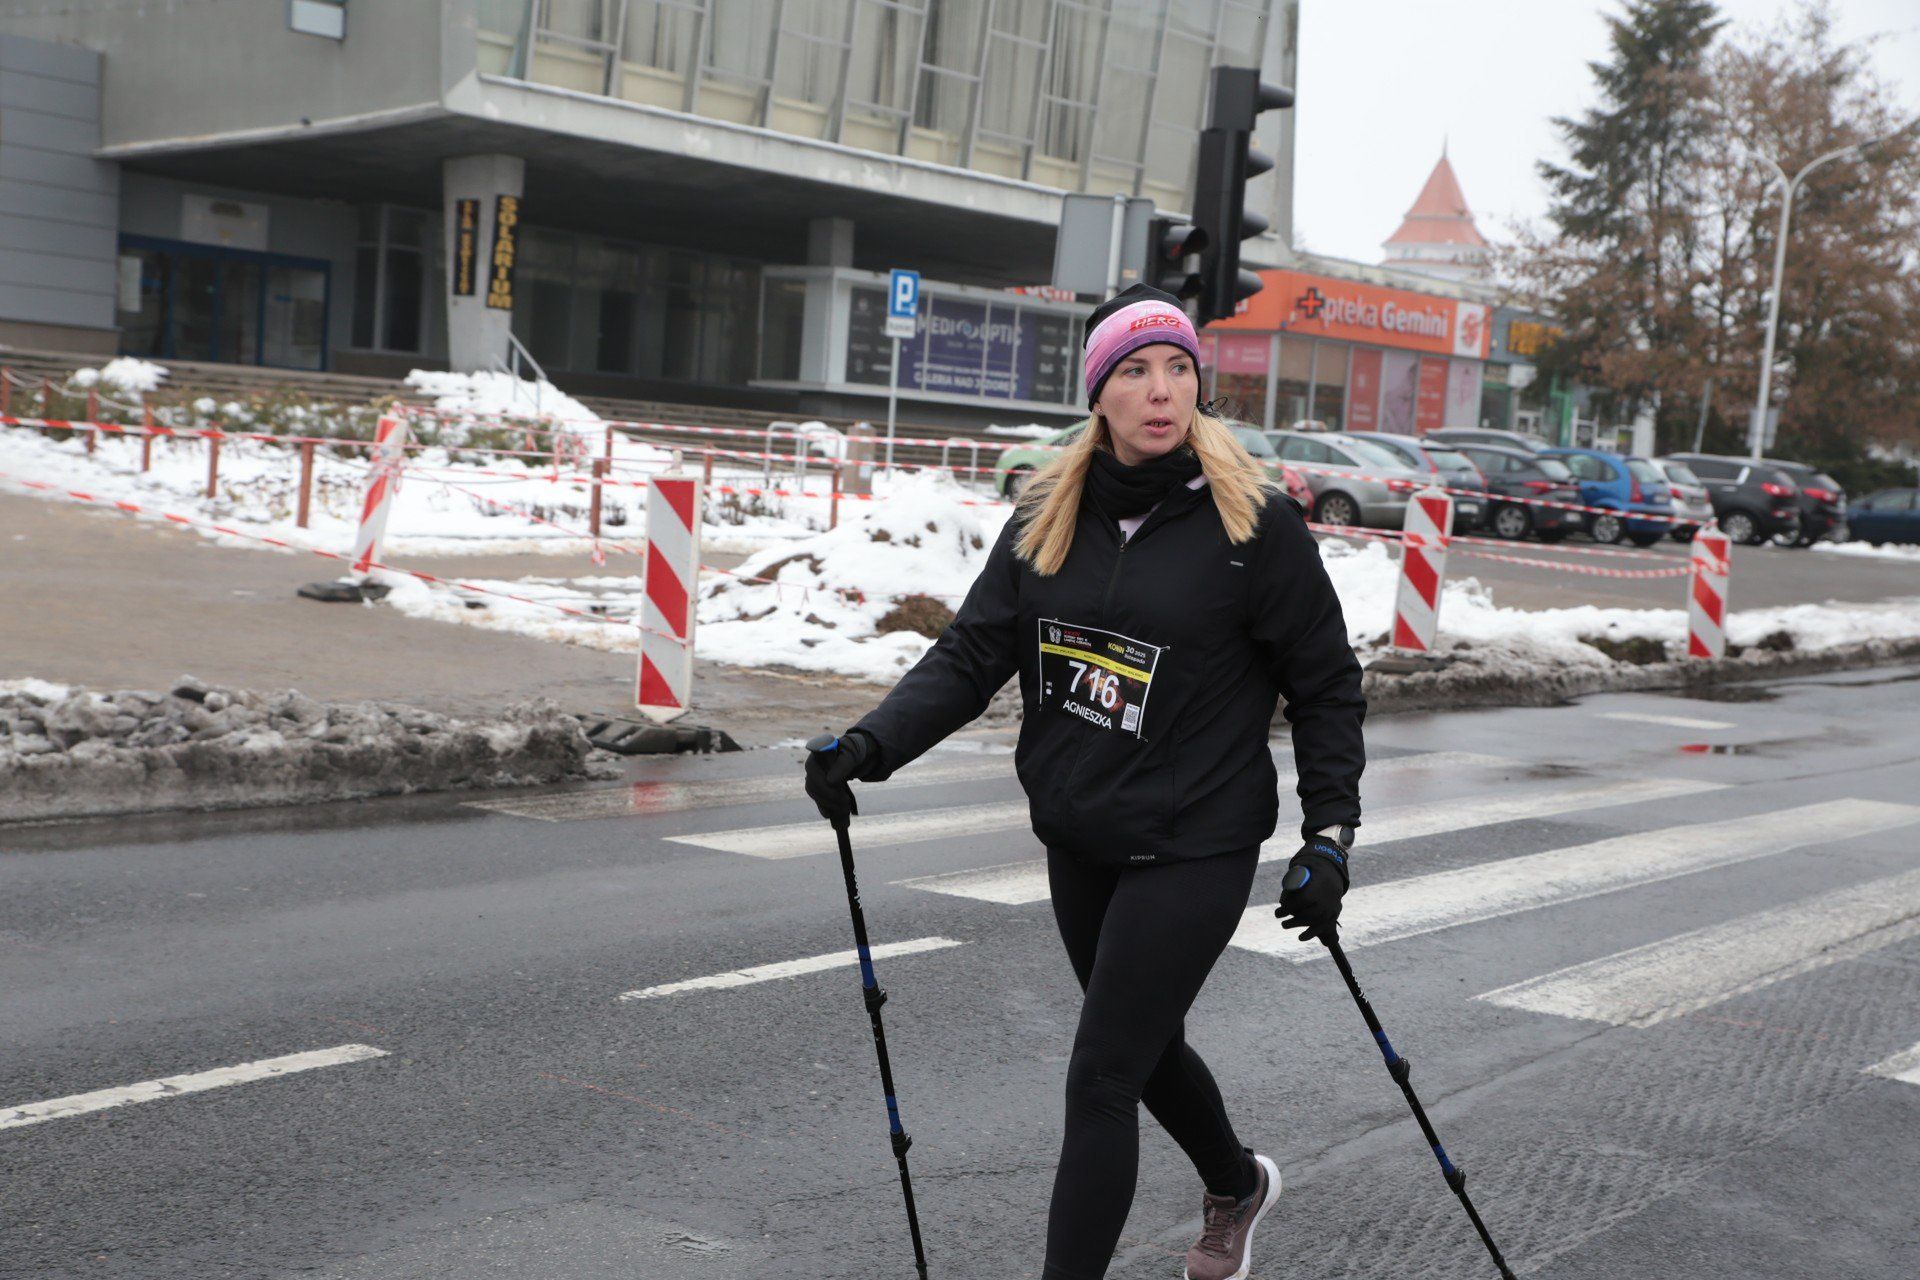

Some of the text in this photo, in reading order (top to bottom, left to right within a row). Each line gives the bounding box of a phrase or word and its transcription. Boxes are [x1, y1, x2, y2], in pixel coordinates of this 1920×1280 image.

[487, 197, 518, 308] SOLARIUM
[895, 275, 914, 312] P
[1381, 302, 1448, 338] Gemini
[1125, 645, 1135, 655] 30
[1068, 660, 1120, 709] 716
[1062, 699, 1112, 730] AGNIESZKA
